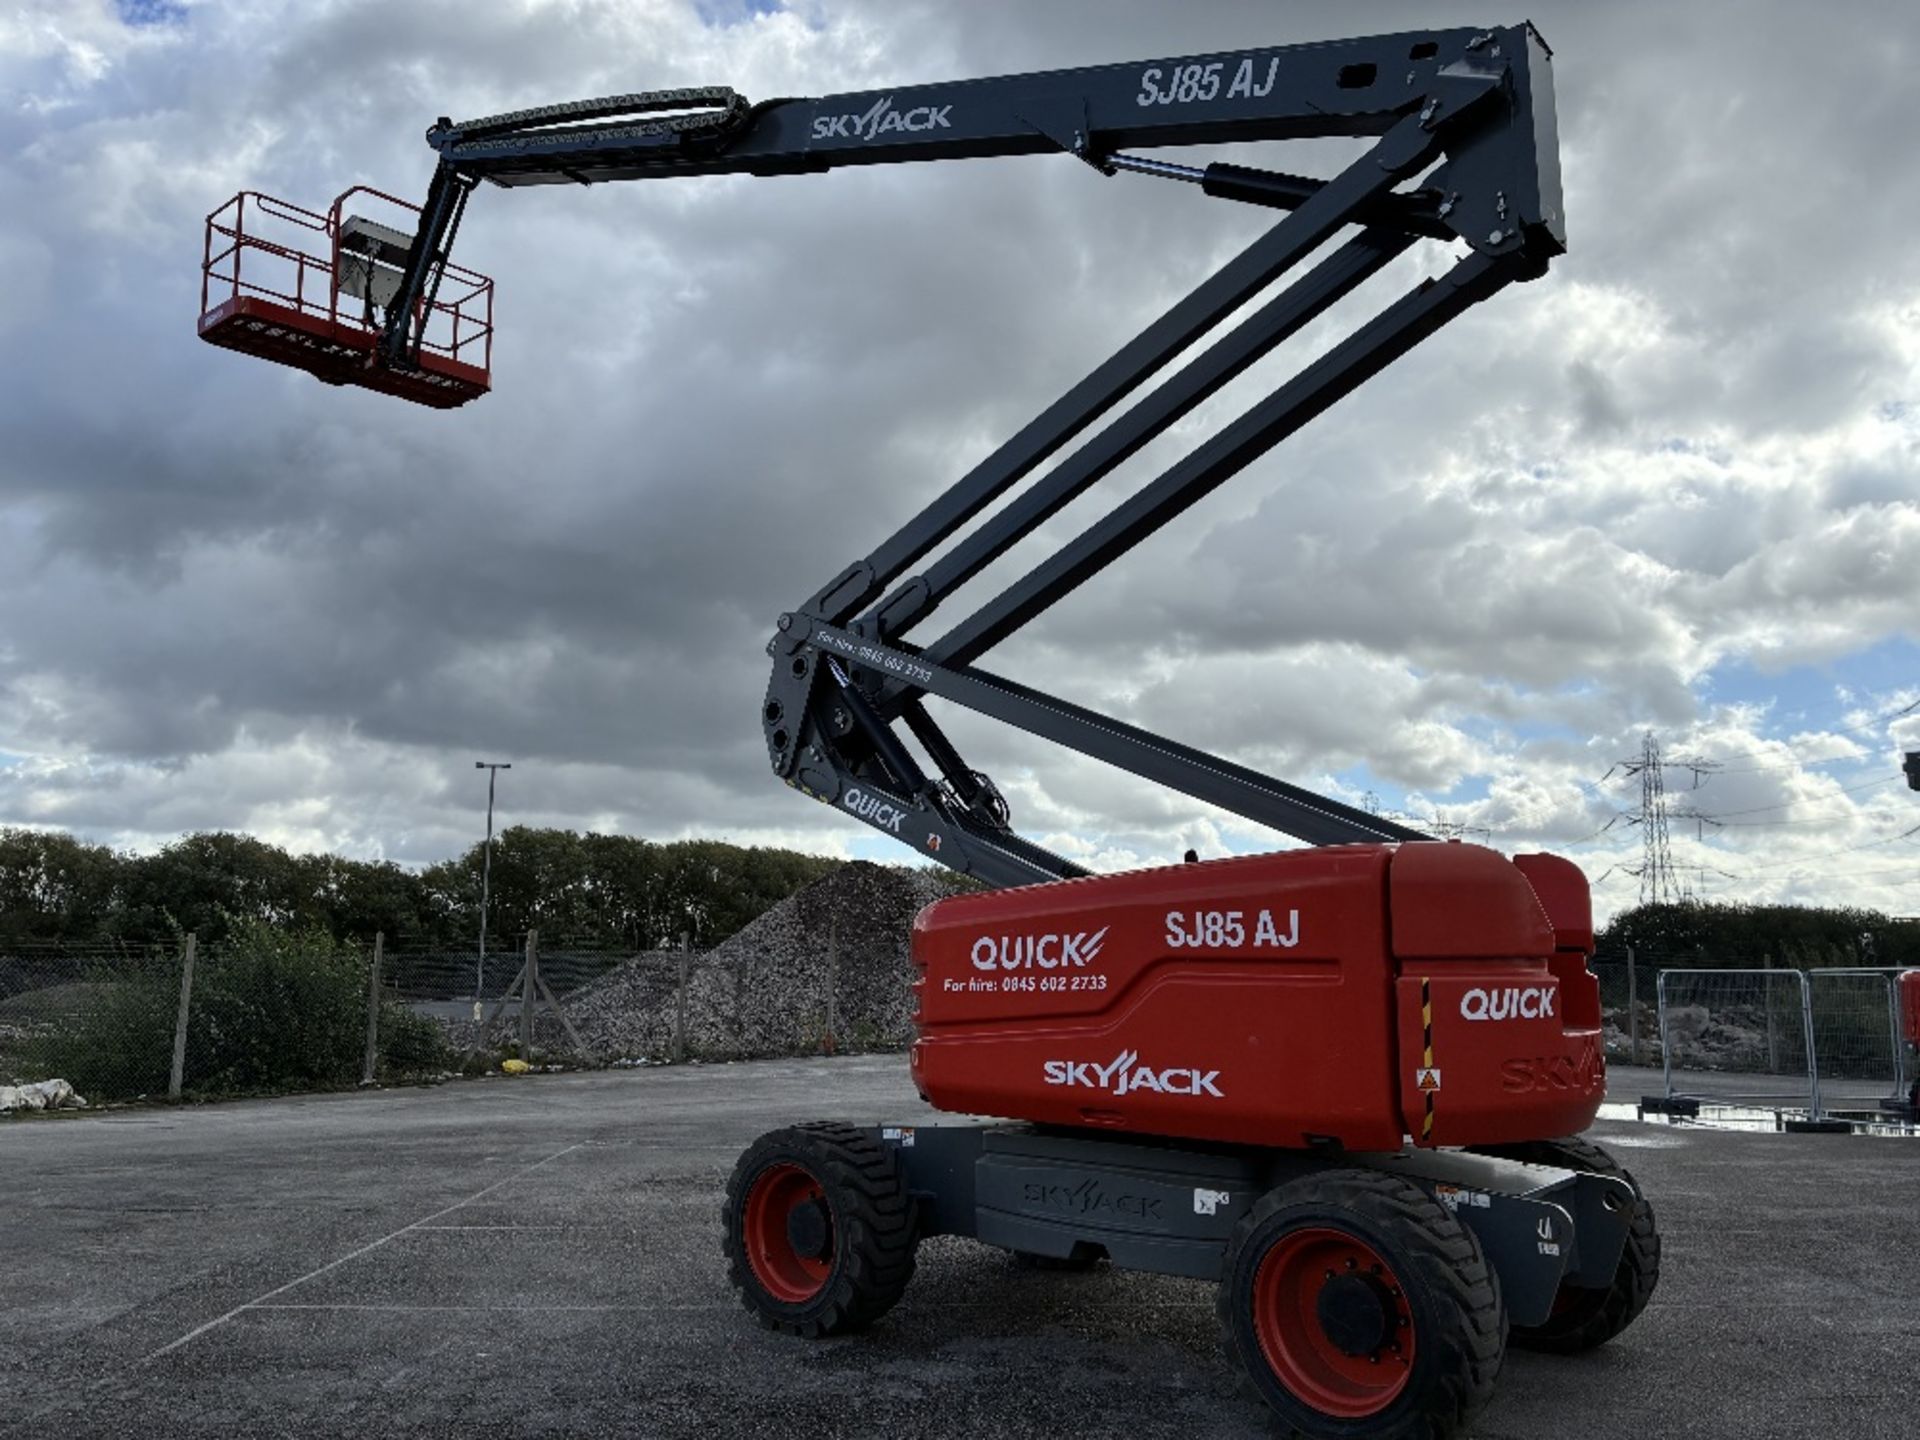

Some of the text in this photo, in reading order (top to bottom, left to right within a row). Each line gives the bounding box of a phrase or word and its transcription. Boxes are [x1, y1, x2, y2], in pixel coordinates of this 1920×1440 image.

[1136, 57, 1279, 106] SJ85 AJ
[811, 96, 953, 141] SKYJACK
[817, 630, 834, 643] For
[844, 788, 908, 833] QUICK
[1165, 909, 1300, 948] SJ85 AJ
[970, 931, 1090, 971] QUICK
[943, 974, 1107, 992] For hire: 0845 602 2733
[1460, 985, 1557, 1021] QUICK
[1043, 1048, 1225, 1097] SKYJACK
[1023, 1177, 1162, 1220] SKYJACK
